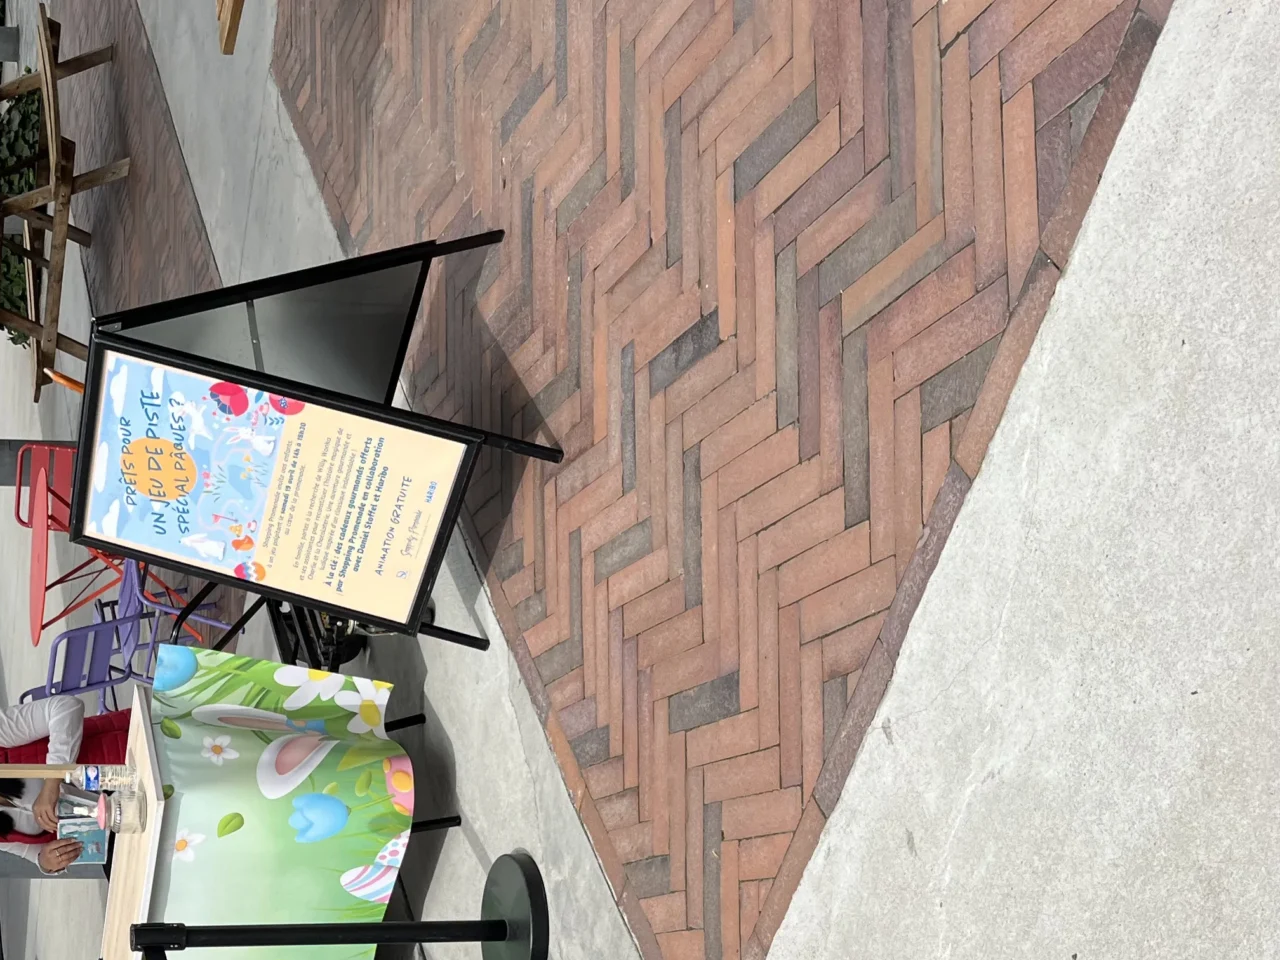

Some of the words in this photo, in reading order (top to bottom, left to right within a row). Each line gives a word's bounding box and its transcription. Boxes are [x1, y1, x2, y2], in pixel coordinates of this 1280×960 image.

[140, 389, 161, 440] PISTE
[168, 398, 185, 407] ?
[120, 416, 134, 455] POUR
[169, 412, 187, 470] PÂQUES
[145, 446, 164, 471] DE
[292, 448, 300, 459] 14h
[359, 437, 373, 464] offerts
[291, 460, 297, 468] de
[365, 437, 385, 490] collaboration
[118, 459, 137, 506] PRÊTS
[287, 469, 296, 484] avril
[347, 466, 365, 509] gourmands
[374, 466, 389, 493] Haribo
[148, 477, 170, 508] JEU
[280, 492, 290, 514] samedi
[362, 491, 370, 501] en
[373, 494, 381, 502] et
[426, 481, 437, 503] HARIBO
[172, 476, 190, 534] SPÉCIAL
[364, 503, 378, 530] Stoffel
[151, 512, 166, 535] UN
[339, 510, 352, 541] cadeaux
[348, 502, 366, 544] Promenade
[374, 526, 395, 576] ANIMATION
[390, 475, 412, 525] GRATUITE
[334, 542, 343, 555] des
[356, 530, 370, 554] Daniel
[329, 559, 338, 571] clé
[338, 545, 355, 578] Shopping
[353, 555, 363, 572] avec
[326, 572, 335, 580] la
[335, 579, 343, 593] par
